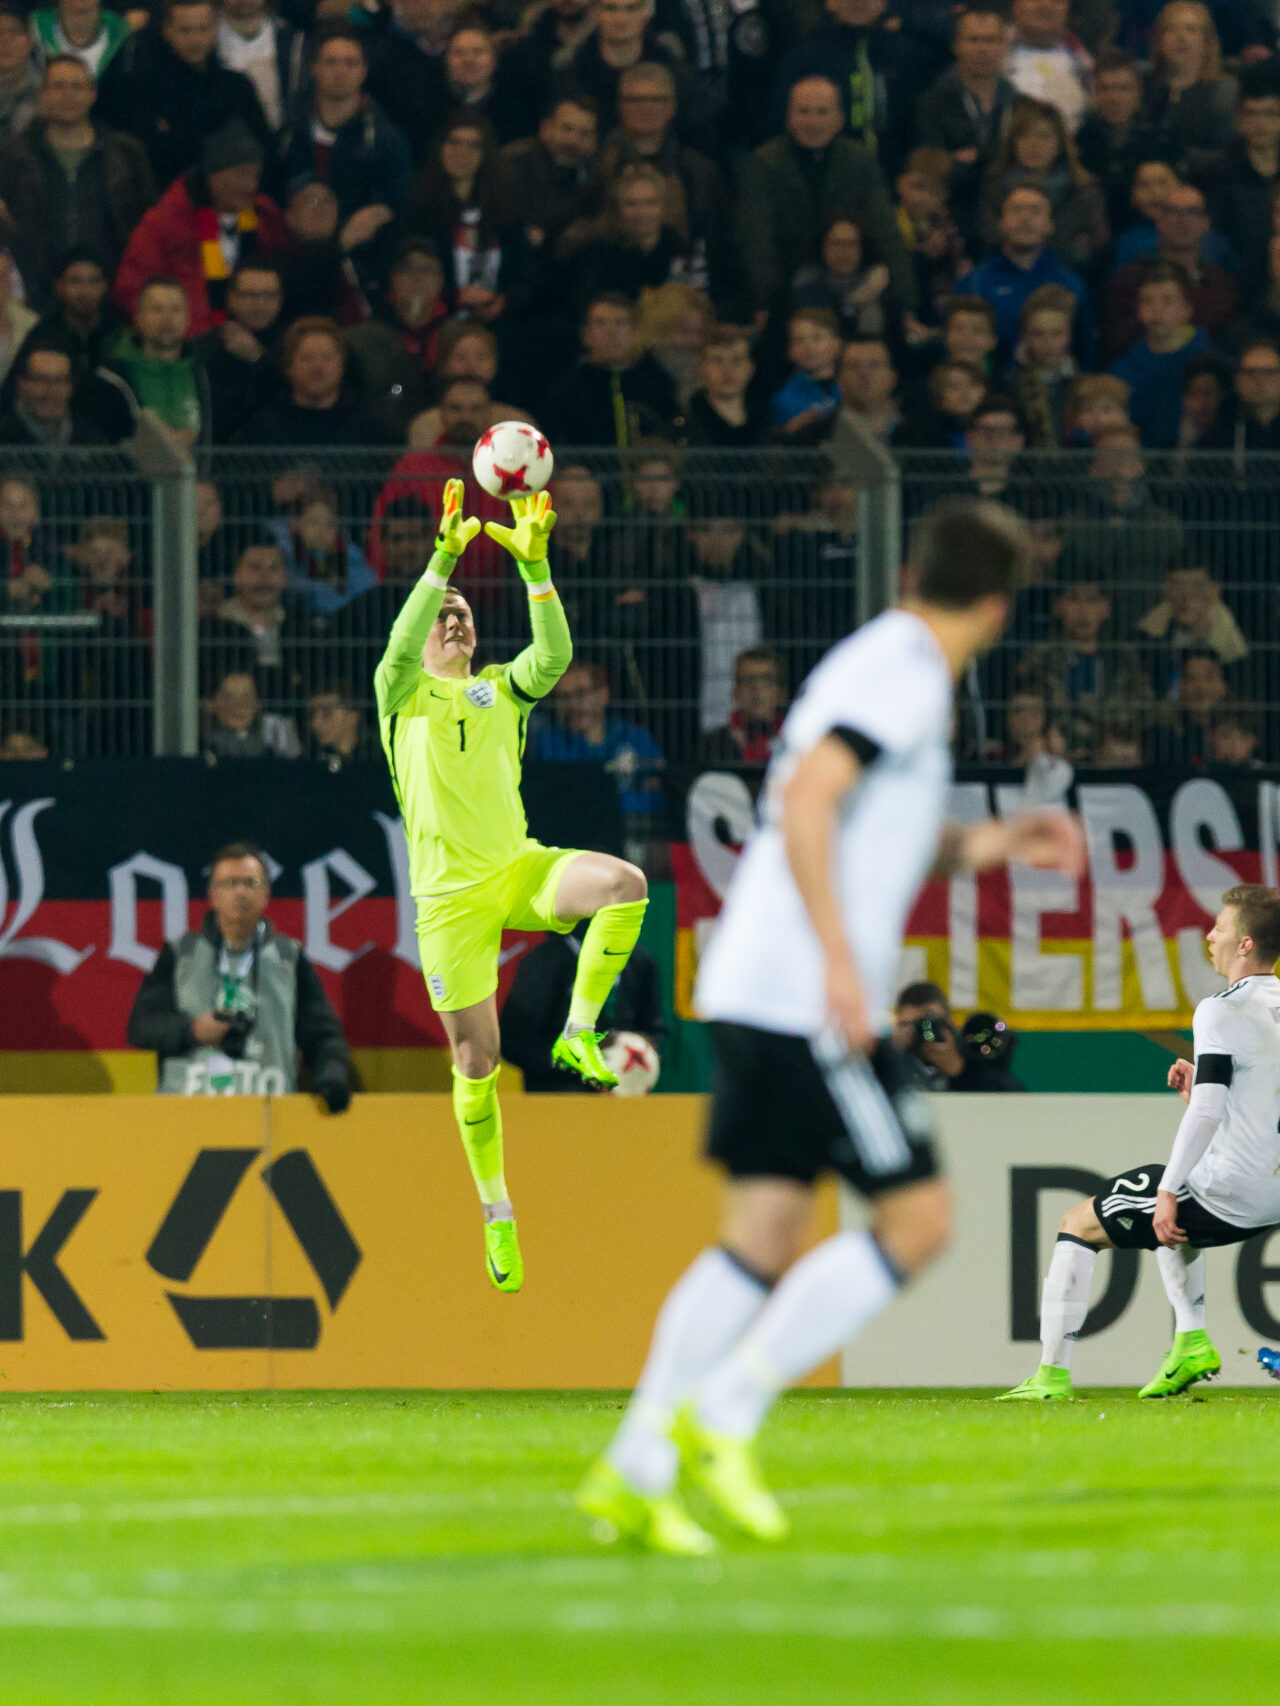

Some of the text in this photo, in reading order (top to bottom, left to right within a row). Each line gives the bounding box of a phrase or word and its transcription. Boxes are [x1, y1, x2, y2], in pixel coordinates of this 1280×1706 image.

[457, 719, 466, 752] 1
[184, 1062, 286, 1097] FTO
[1111, 1172, 1150, 1194] 2
[0, 1189, 107, 1341] K
